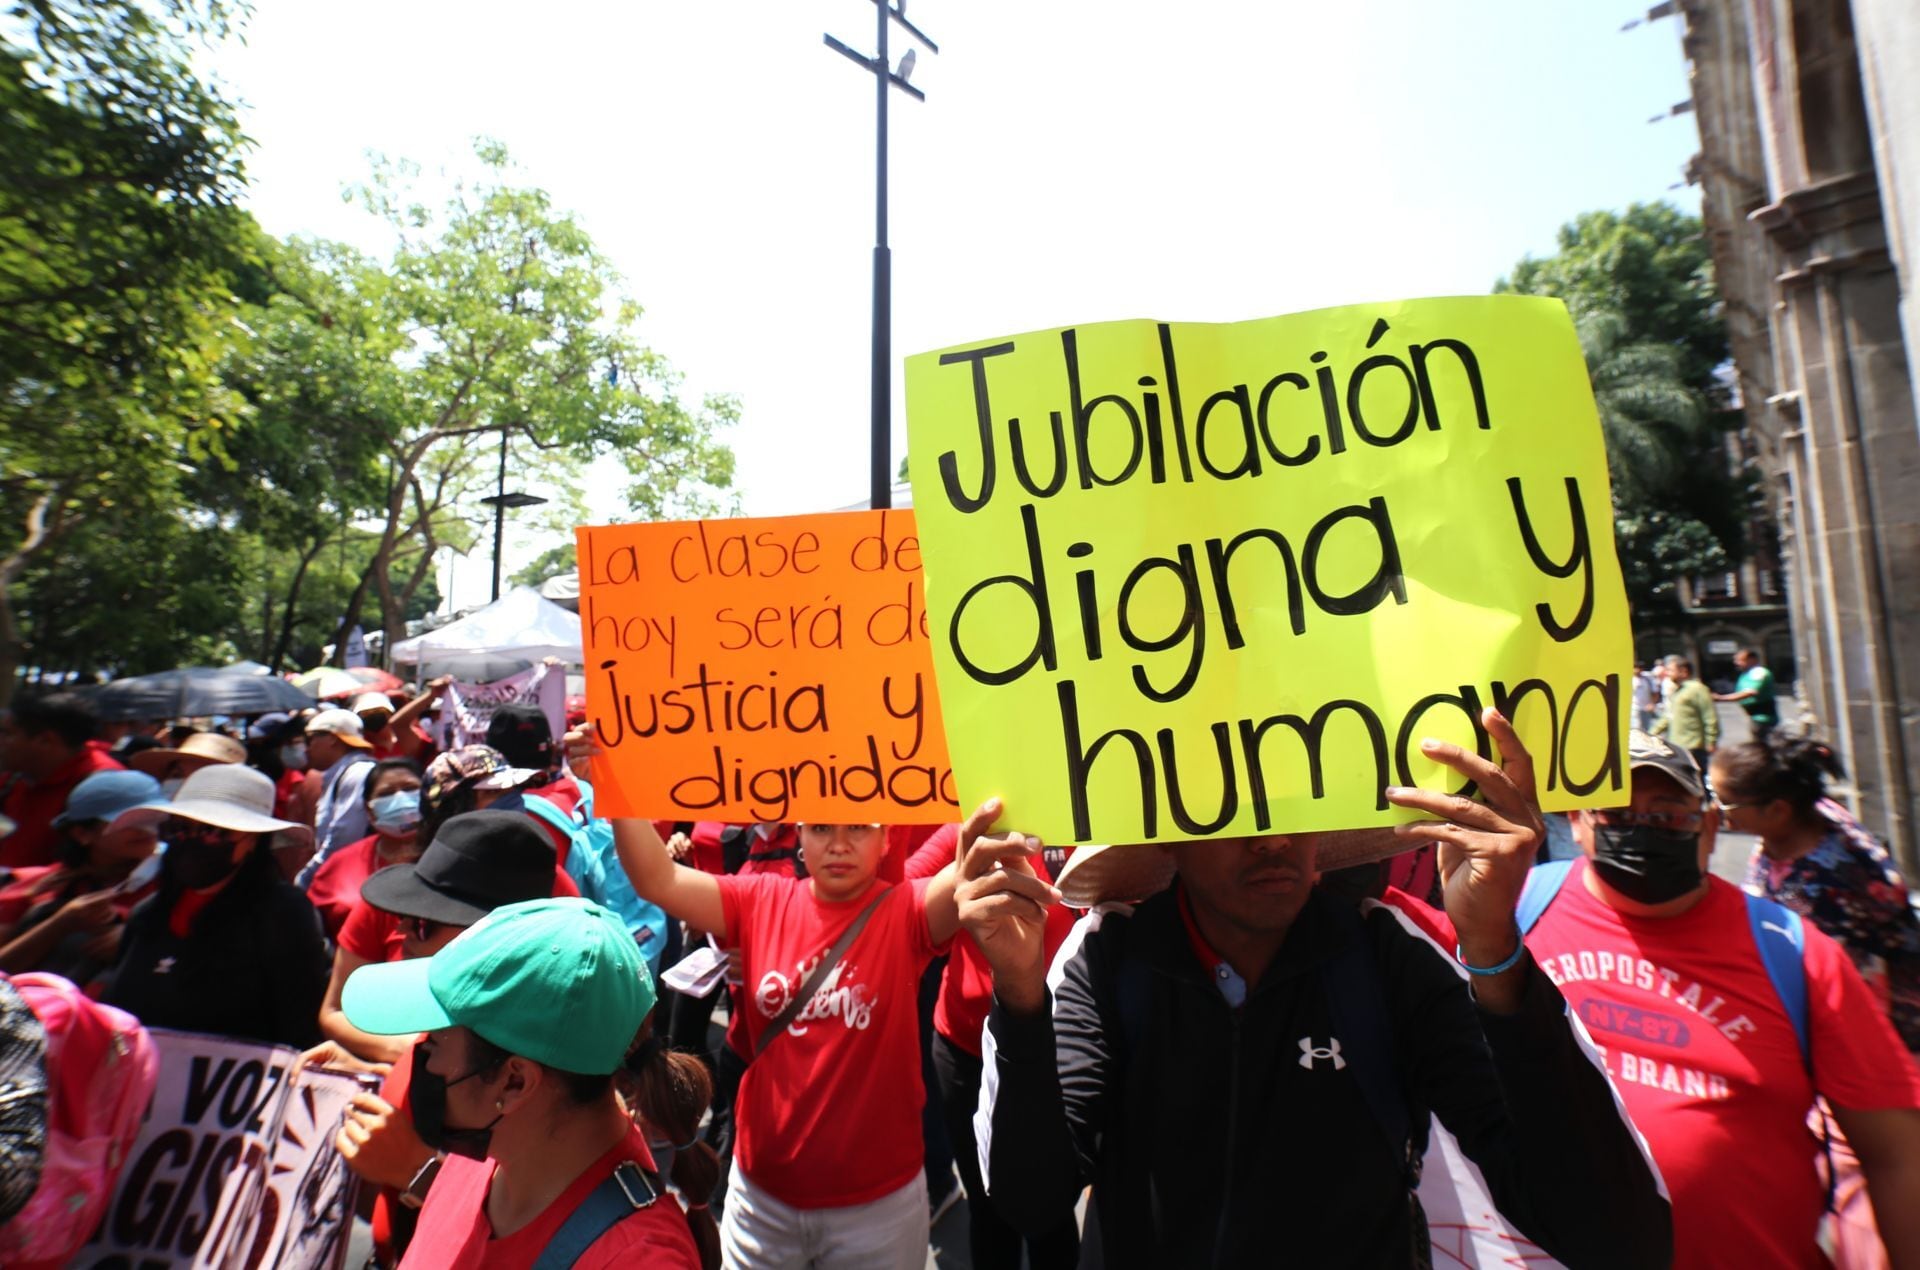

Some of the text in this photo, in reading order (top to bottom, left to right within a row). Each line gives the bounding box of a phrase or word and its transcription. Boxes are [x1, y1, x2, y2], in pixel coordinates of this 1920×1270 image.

[937, 318, 1491, 514] Jubilación
[588, 510, 923, 586] La clase de
[948, 476, 1594, 703] digna y
[589, 596, 676, 679] hoy
[716, 595, 842, 650] será
[883, 672, 924, 760] y
[1057, 674, 1624, 842] humana
[755, 970, 878, 1037] Qeens
[1541, 950, 1757, 1042] EROPOSTALE
[1588, 1002, 1681, 1045] NY-87
[182, 1056, 283, 1134] VOZ
[1620, 1051, 1731, 1100] BRAND
